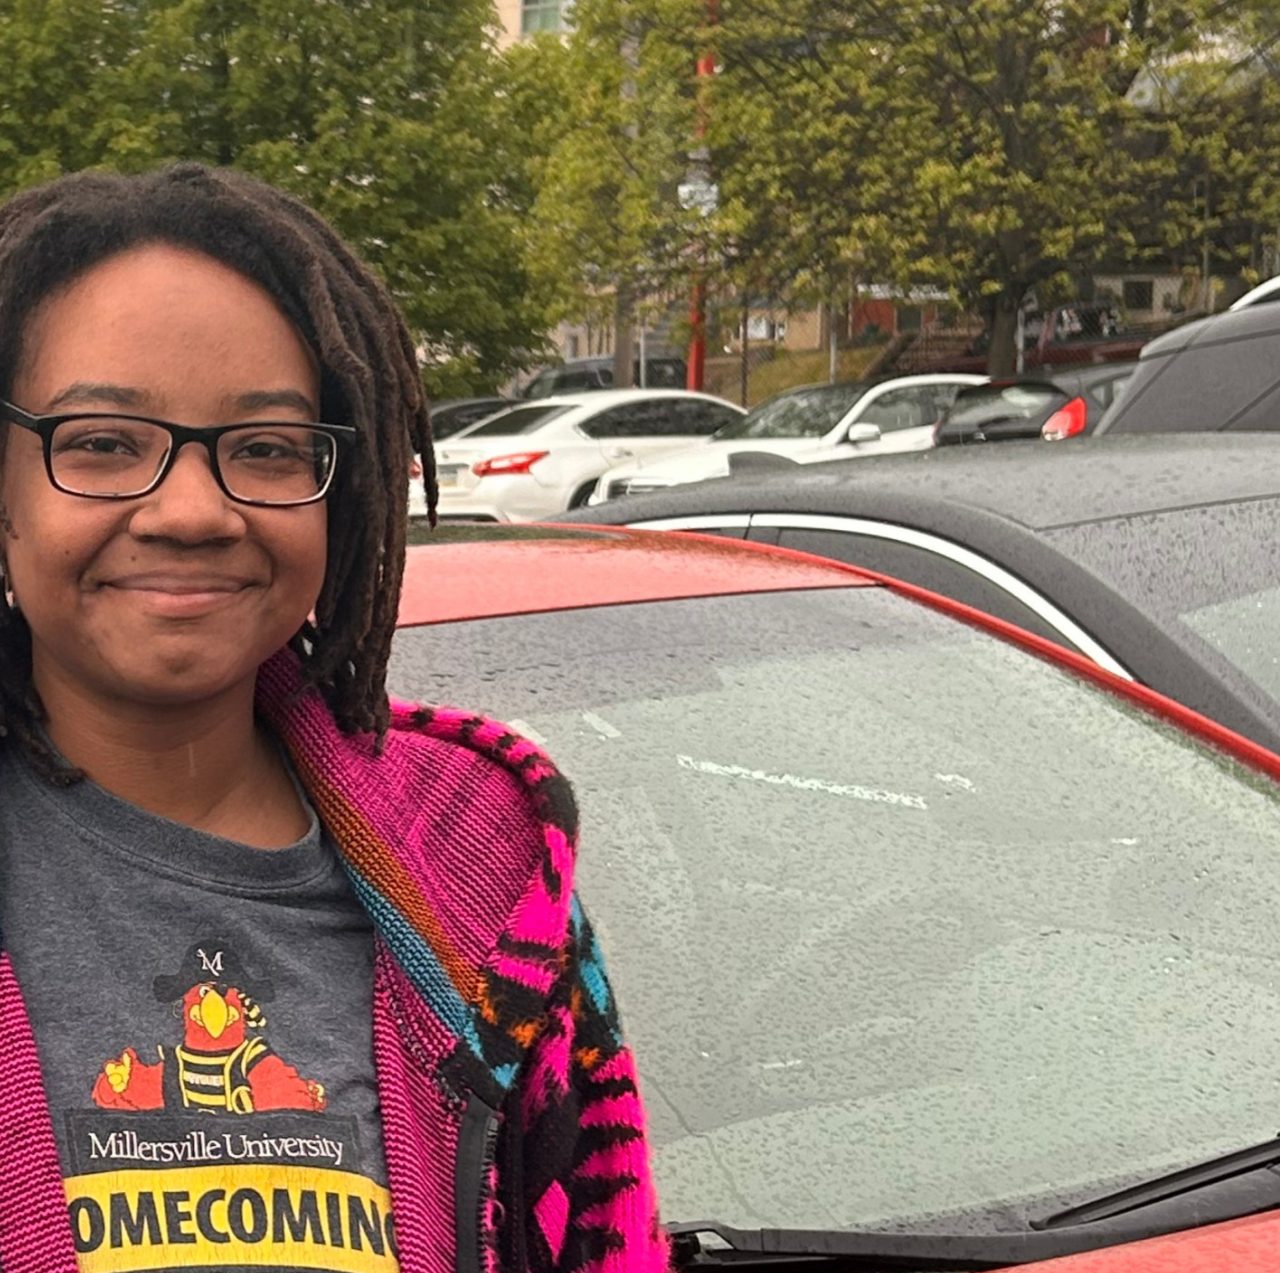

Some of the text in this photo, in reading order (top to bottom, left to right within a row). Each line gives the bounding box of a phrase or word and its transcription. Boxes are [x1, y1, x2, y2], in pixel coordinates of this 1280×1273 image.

[196, 948, 225, 977] M
[88, 1130, 344, 1165] Millersville University
